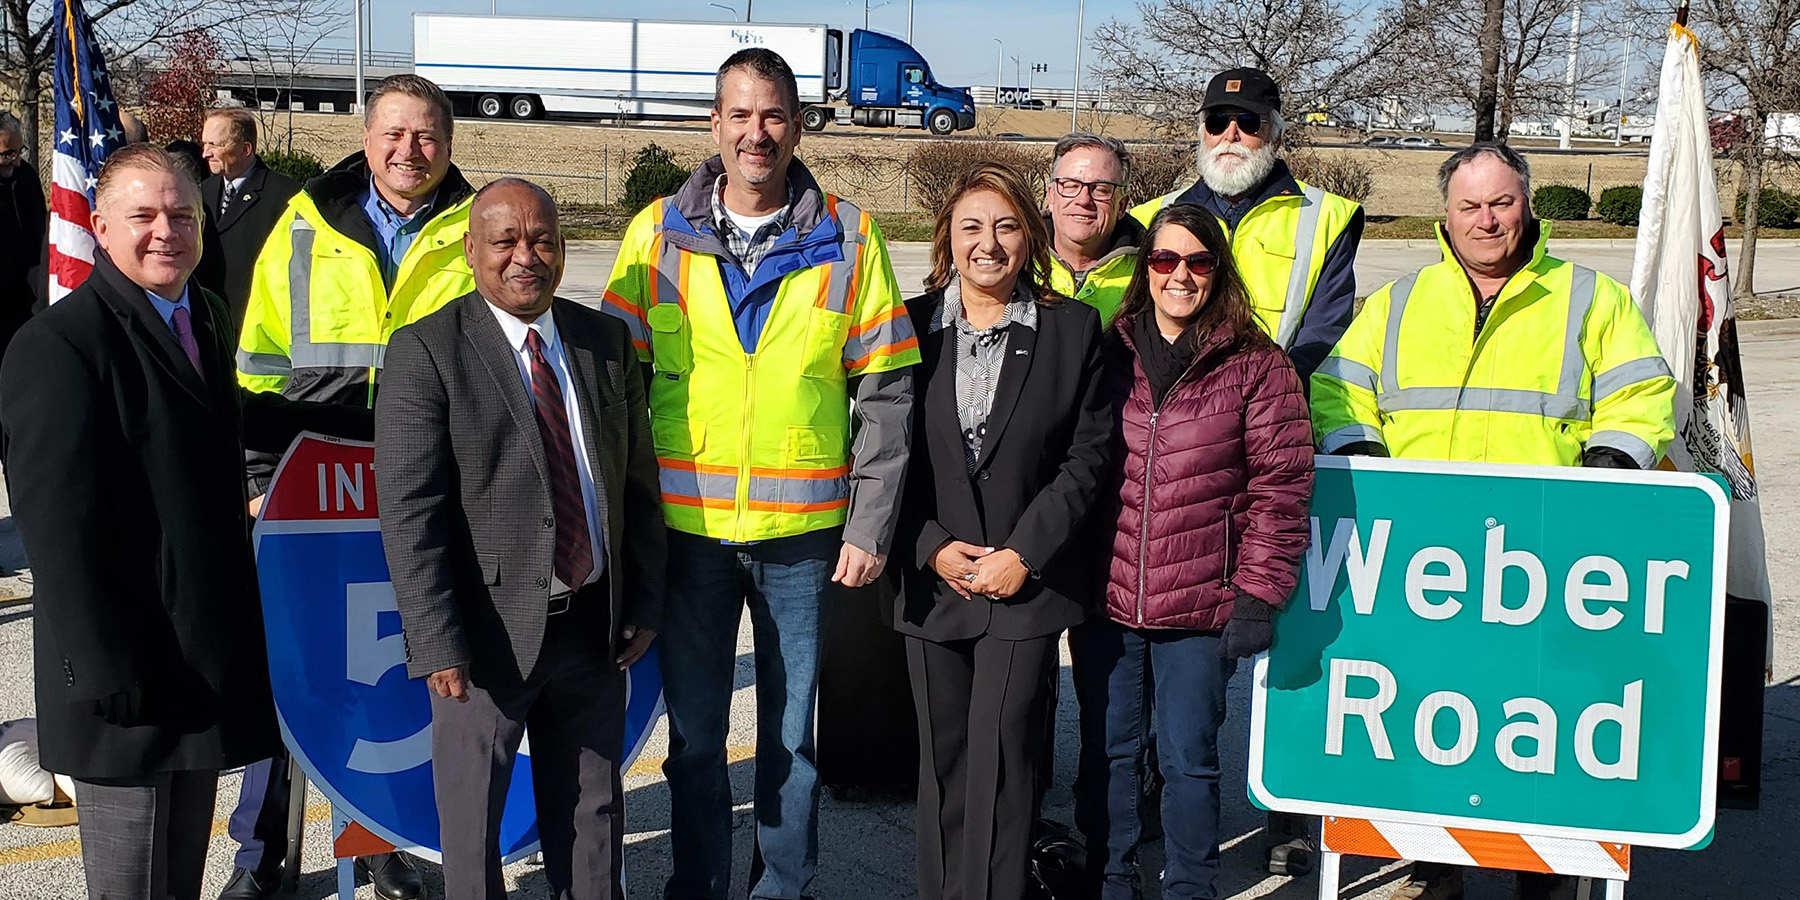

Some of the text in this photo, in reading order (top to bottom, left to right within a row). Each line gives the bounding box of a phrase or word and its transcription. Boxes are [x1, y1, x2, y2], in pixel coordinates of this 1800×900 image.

[1700, 434, 1720, 457] 1818
[1701, 418, 1722, 443] 1868
[317, 463, 375, 511] IN
[1305, 516, 1690, 635] Weber
[1325, 658, 1643, 781] Road
